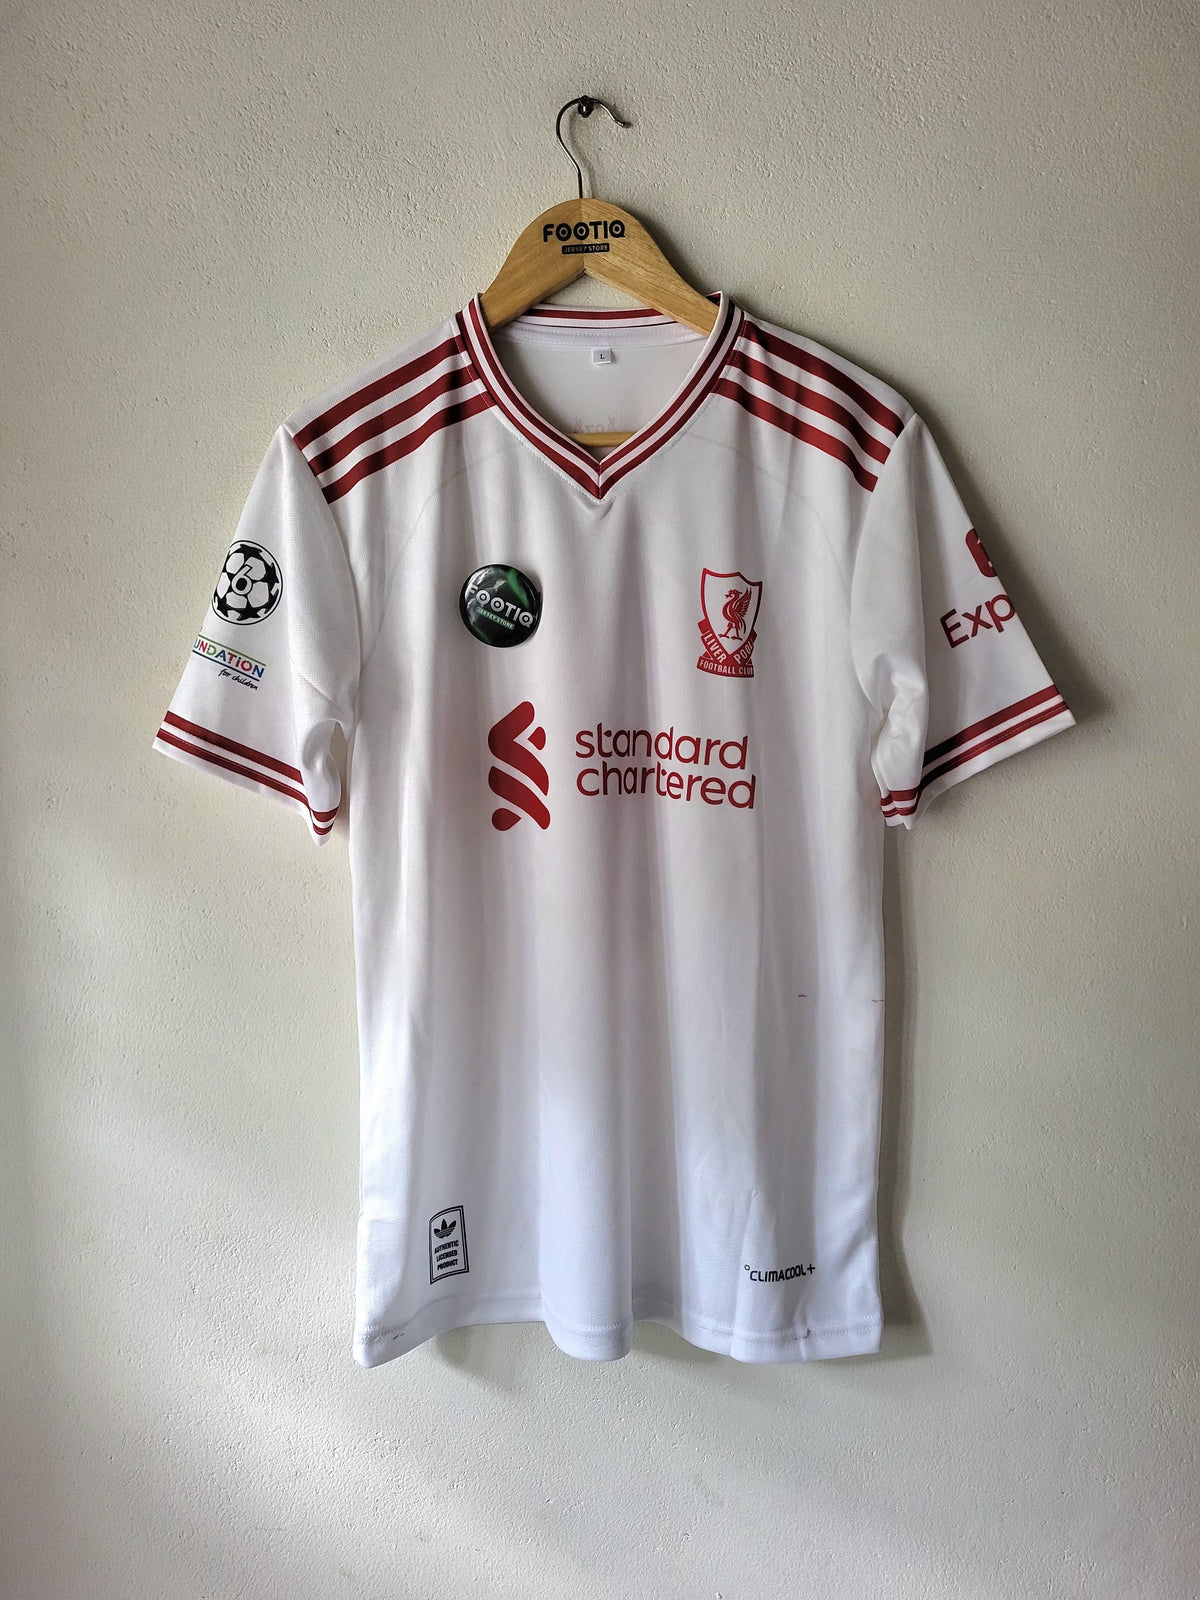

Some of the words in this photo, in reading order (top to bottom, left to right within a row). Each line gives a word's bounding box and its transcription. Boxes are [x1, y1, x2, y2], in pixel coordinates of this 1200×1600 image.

[543, 220, 626, 242] FOOTIQ
[563, 246, 587, 254] JERSEY
[588, 244, 609, 252] STORE
[468, 583, 534, 628] FOOTIQ
[477, 607, 496, 620] JERSEY
[496, 616, 515, 630] STORE
[704, 633, 727, 663] LIVER
[699, 659, 736, 675] FOOTBALL
[218, 668, 231, 677] for
[231, 674, 259, 690] children
[575, 722, 748, 770] standard
[576, 760, 757, 809] chartered
[434, 1239, 459, 1255] AUTHENTIC
[436, 1249, 458, 1262] LICENSED
[437, 1258, 458, 1271] PRODUCT
